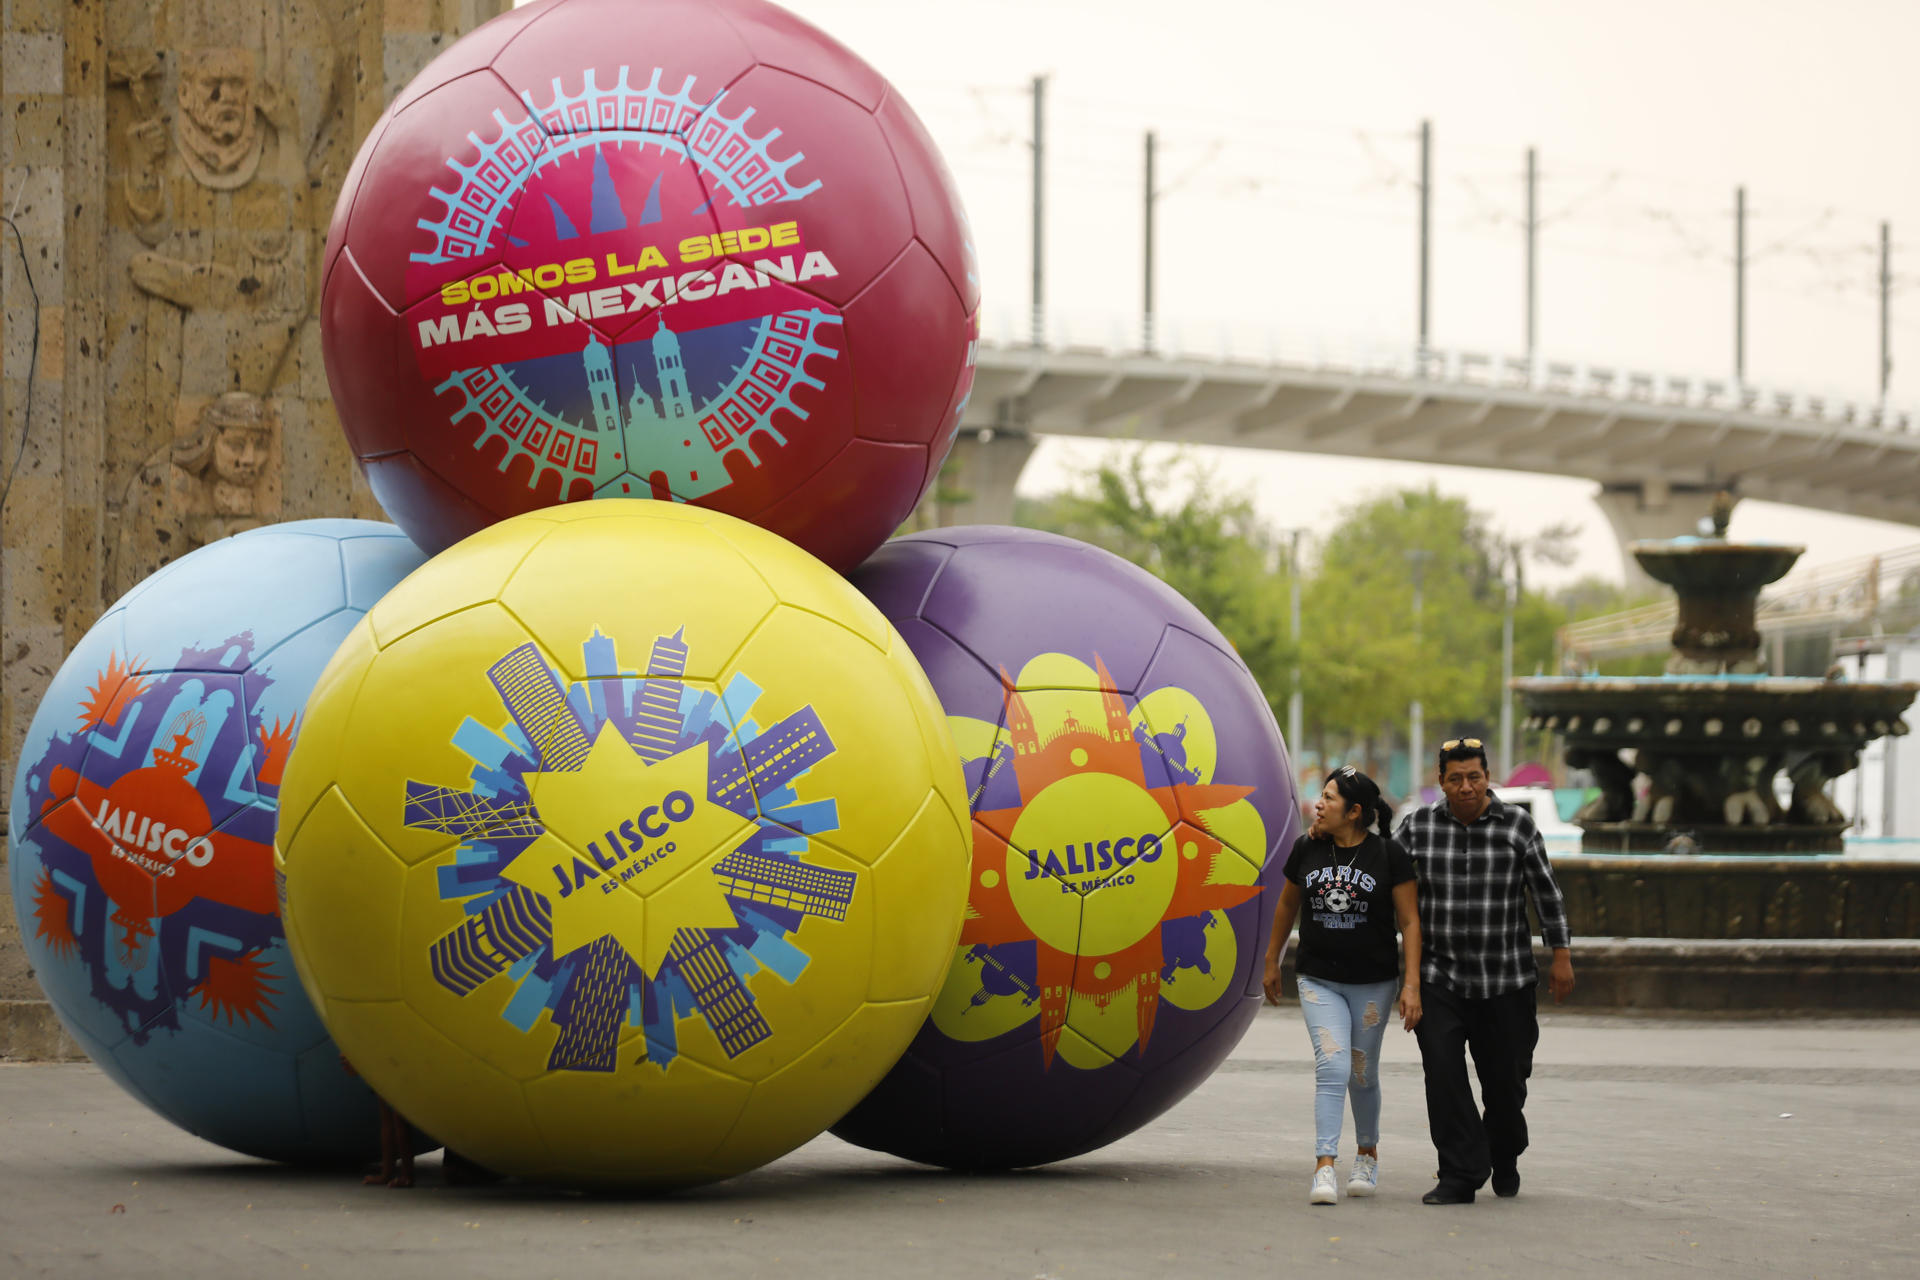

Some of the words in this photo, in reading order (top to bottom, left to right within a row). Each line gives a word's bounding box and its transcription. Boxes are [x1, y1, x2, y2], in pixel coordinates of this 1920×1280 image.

[441, 257, 597, 306] SOMOS
[606, 246, 669, 278] LA
[678, 220, 801, 264] SEDE
[417, 302, 532, 349] MÁS
[543, 250, 839, 327] MEXICANA
[91, 798, 215, 868] JALISCO
[552, 790, 695, 899] JALISCO
[1024, 833, 1163, 881] JALISCO
[111, 844, 126, 859] ES
[126, 851, 177, 878] MÉXICO
[601, 878, 620, 895] ES
[620, 841, 677, 882] MÉXICO
[1061, 882, 1077, 894] ES
[1081, 874, 1136, 892] MÉXICO
[1305, 865, 1377, 892] PARIS
[1352, 900, 1369, 913] 70
